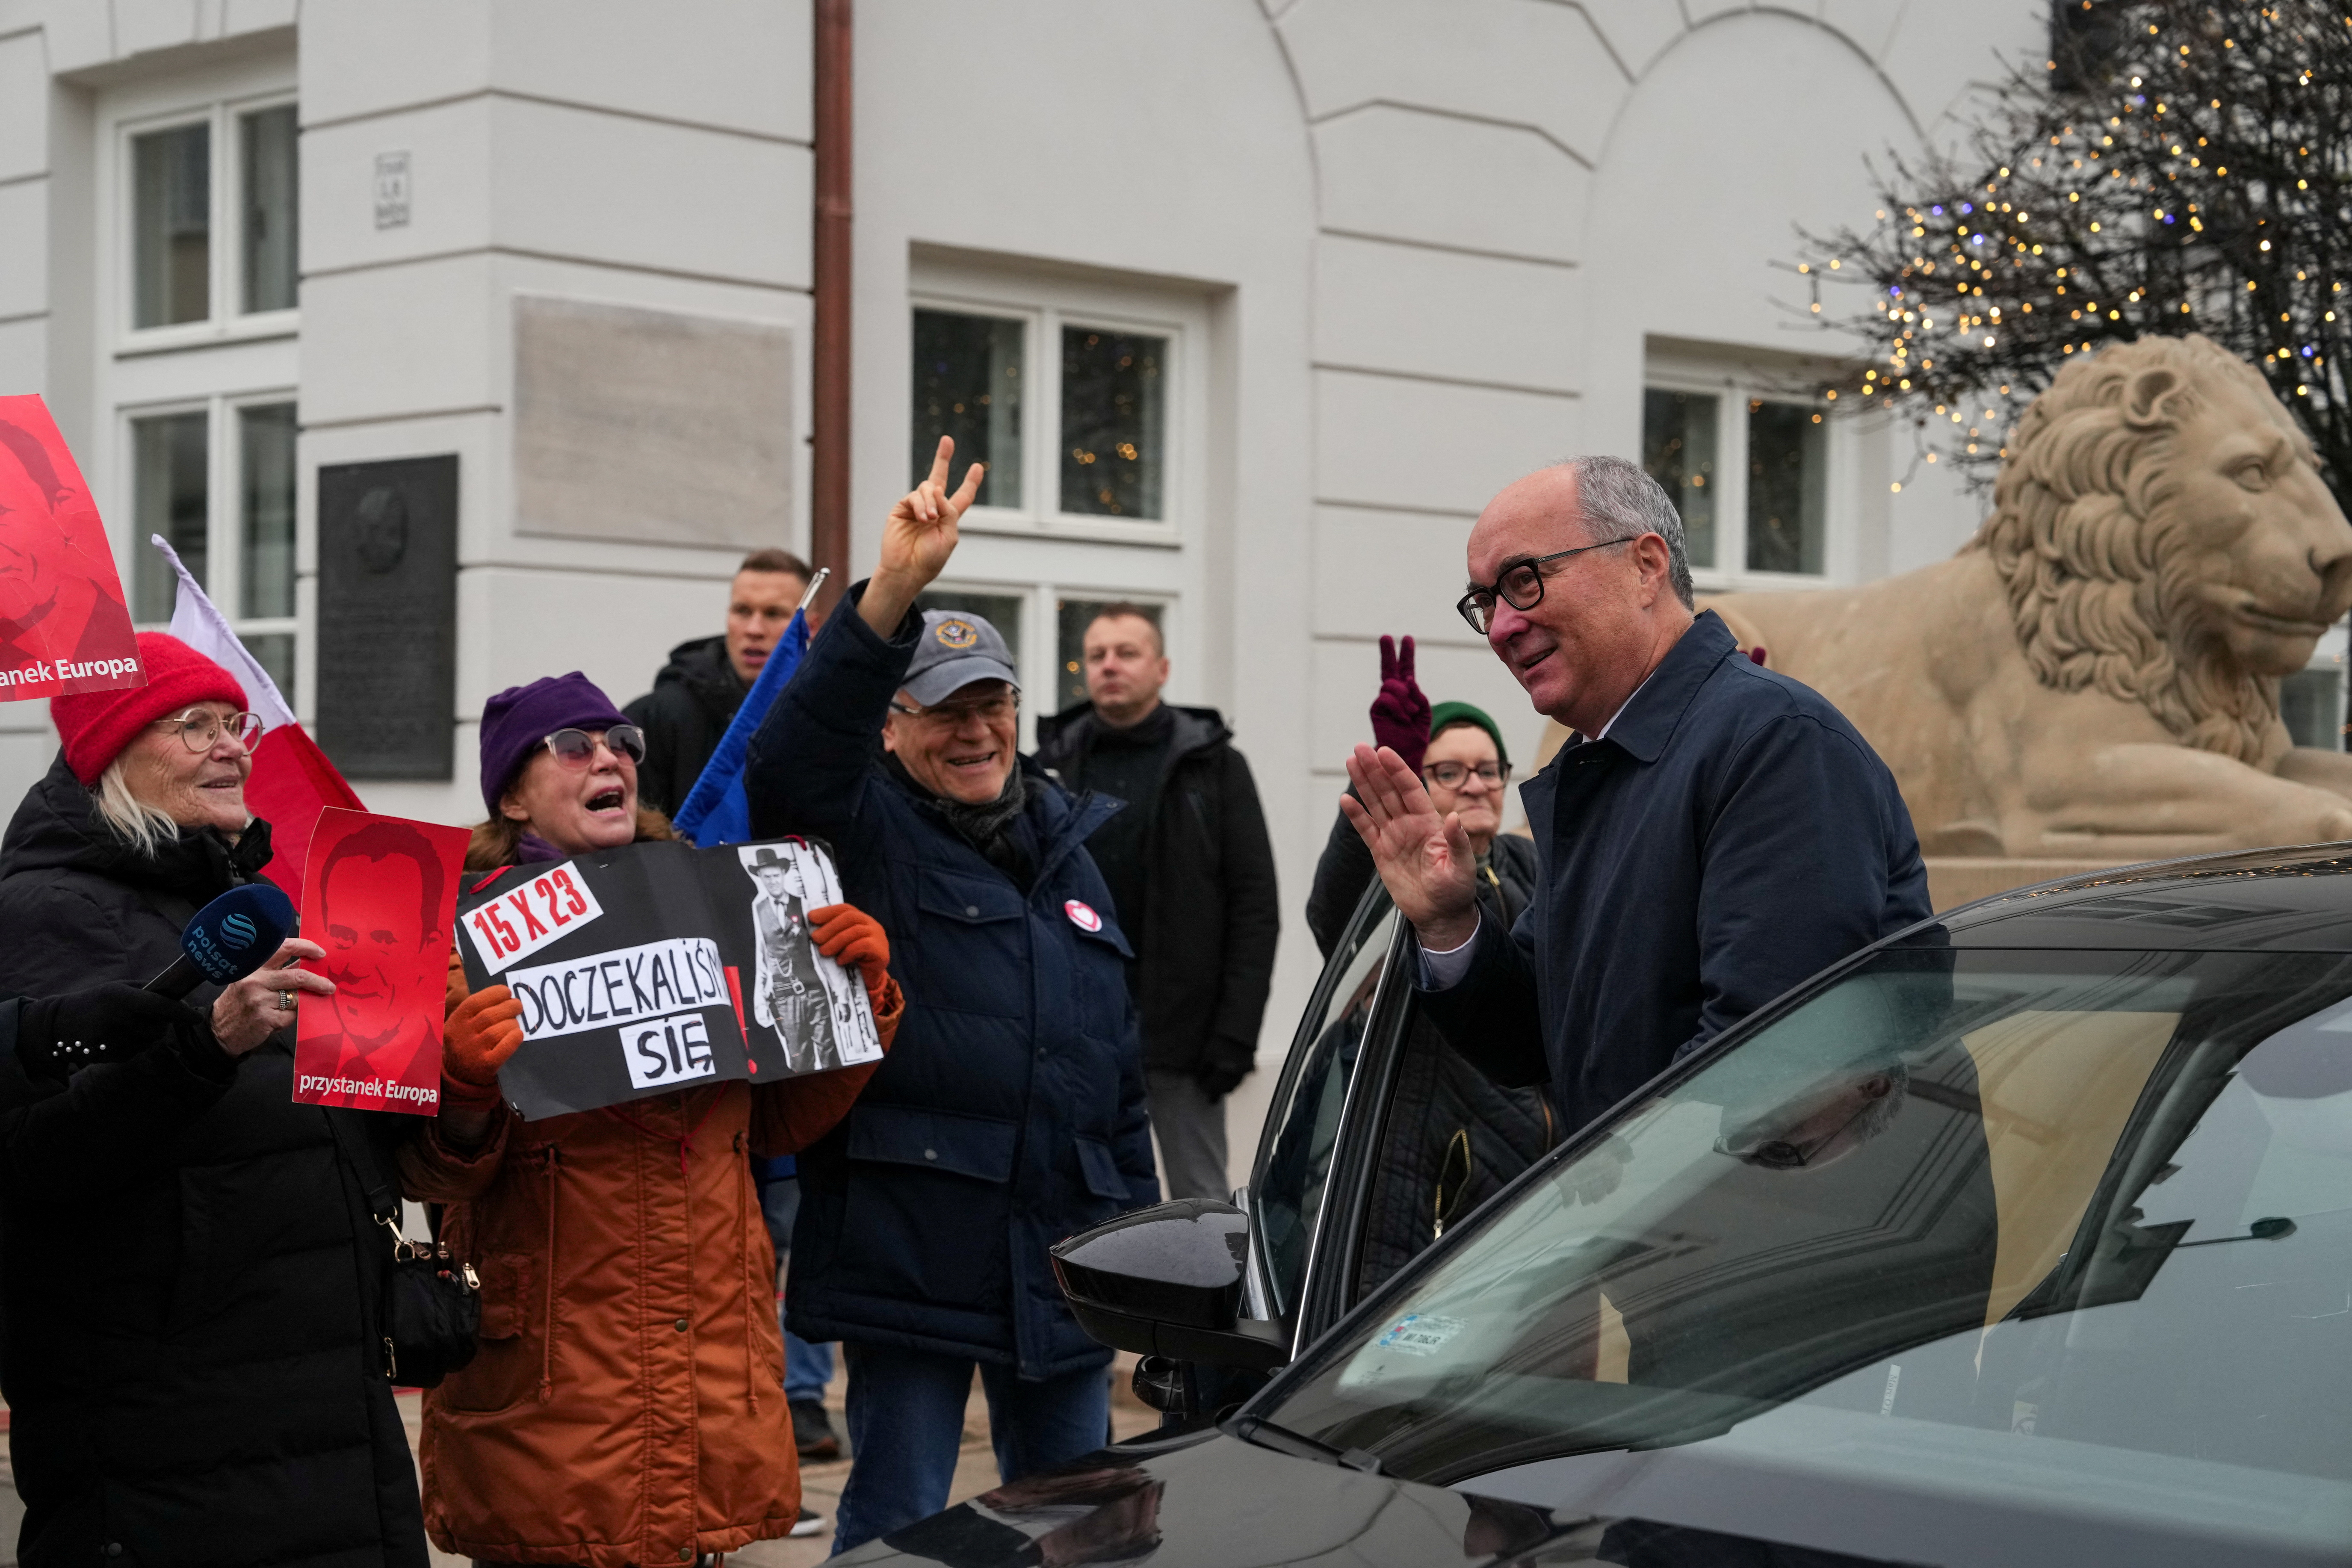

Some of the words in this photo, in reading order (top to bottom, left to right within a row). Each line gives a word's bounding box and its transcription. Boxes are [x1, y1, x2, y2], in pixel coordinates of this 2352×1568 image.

[0, 661, 54, 686] anek
[55, 657, 138, 679] Europa
[473, 903, 521, 959] 15
[508, 889, 549, 941] X
[535, 869, 587, 927] 23
[188, 940, 223, 978] news
[192, 926, 237, 974] polsat
[638, 1017, 712, 1079] SIĘ
[299, 1075, 384, 1096] przystanek
[385, 1080, 437, 1106] Europa
